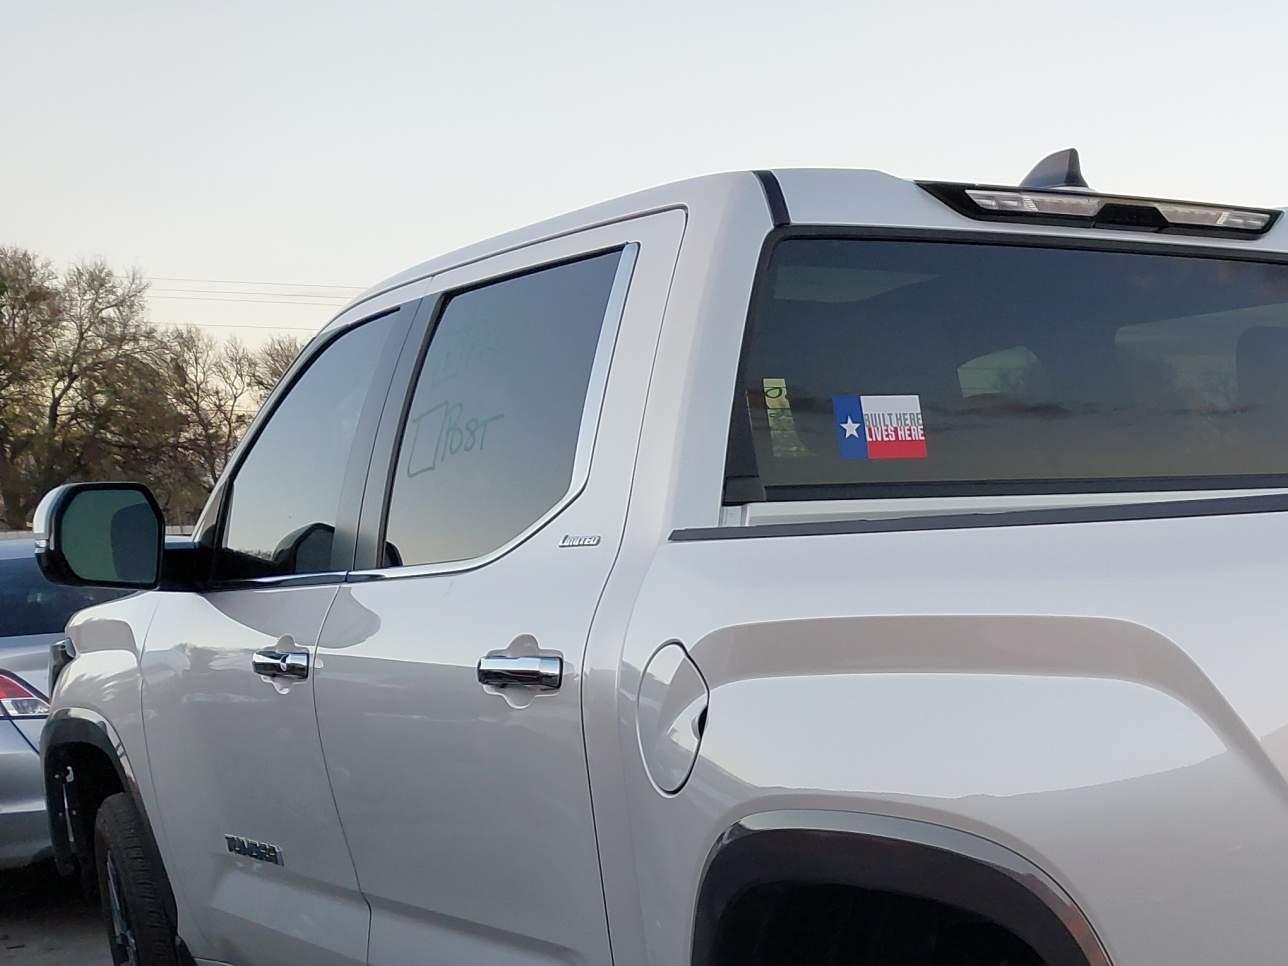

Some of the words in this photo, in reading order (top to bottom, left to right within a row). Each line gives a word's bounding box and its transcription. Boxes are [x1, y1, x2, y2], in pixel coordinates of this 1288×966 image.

[895, 412, 922, 427] HERE
[866, 426, 896, 441] LIVES
[897, 425, 925, 440] HERE
